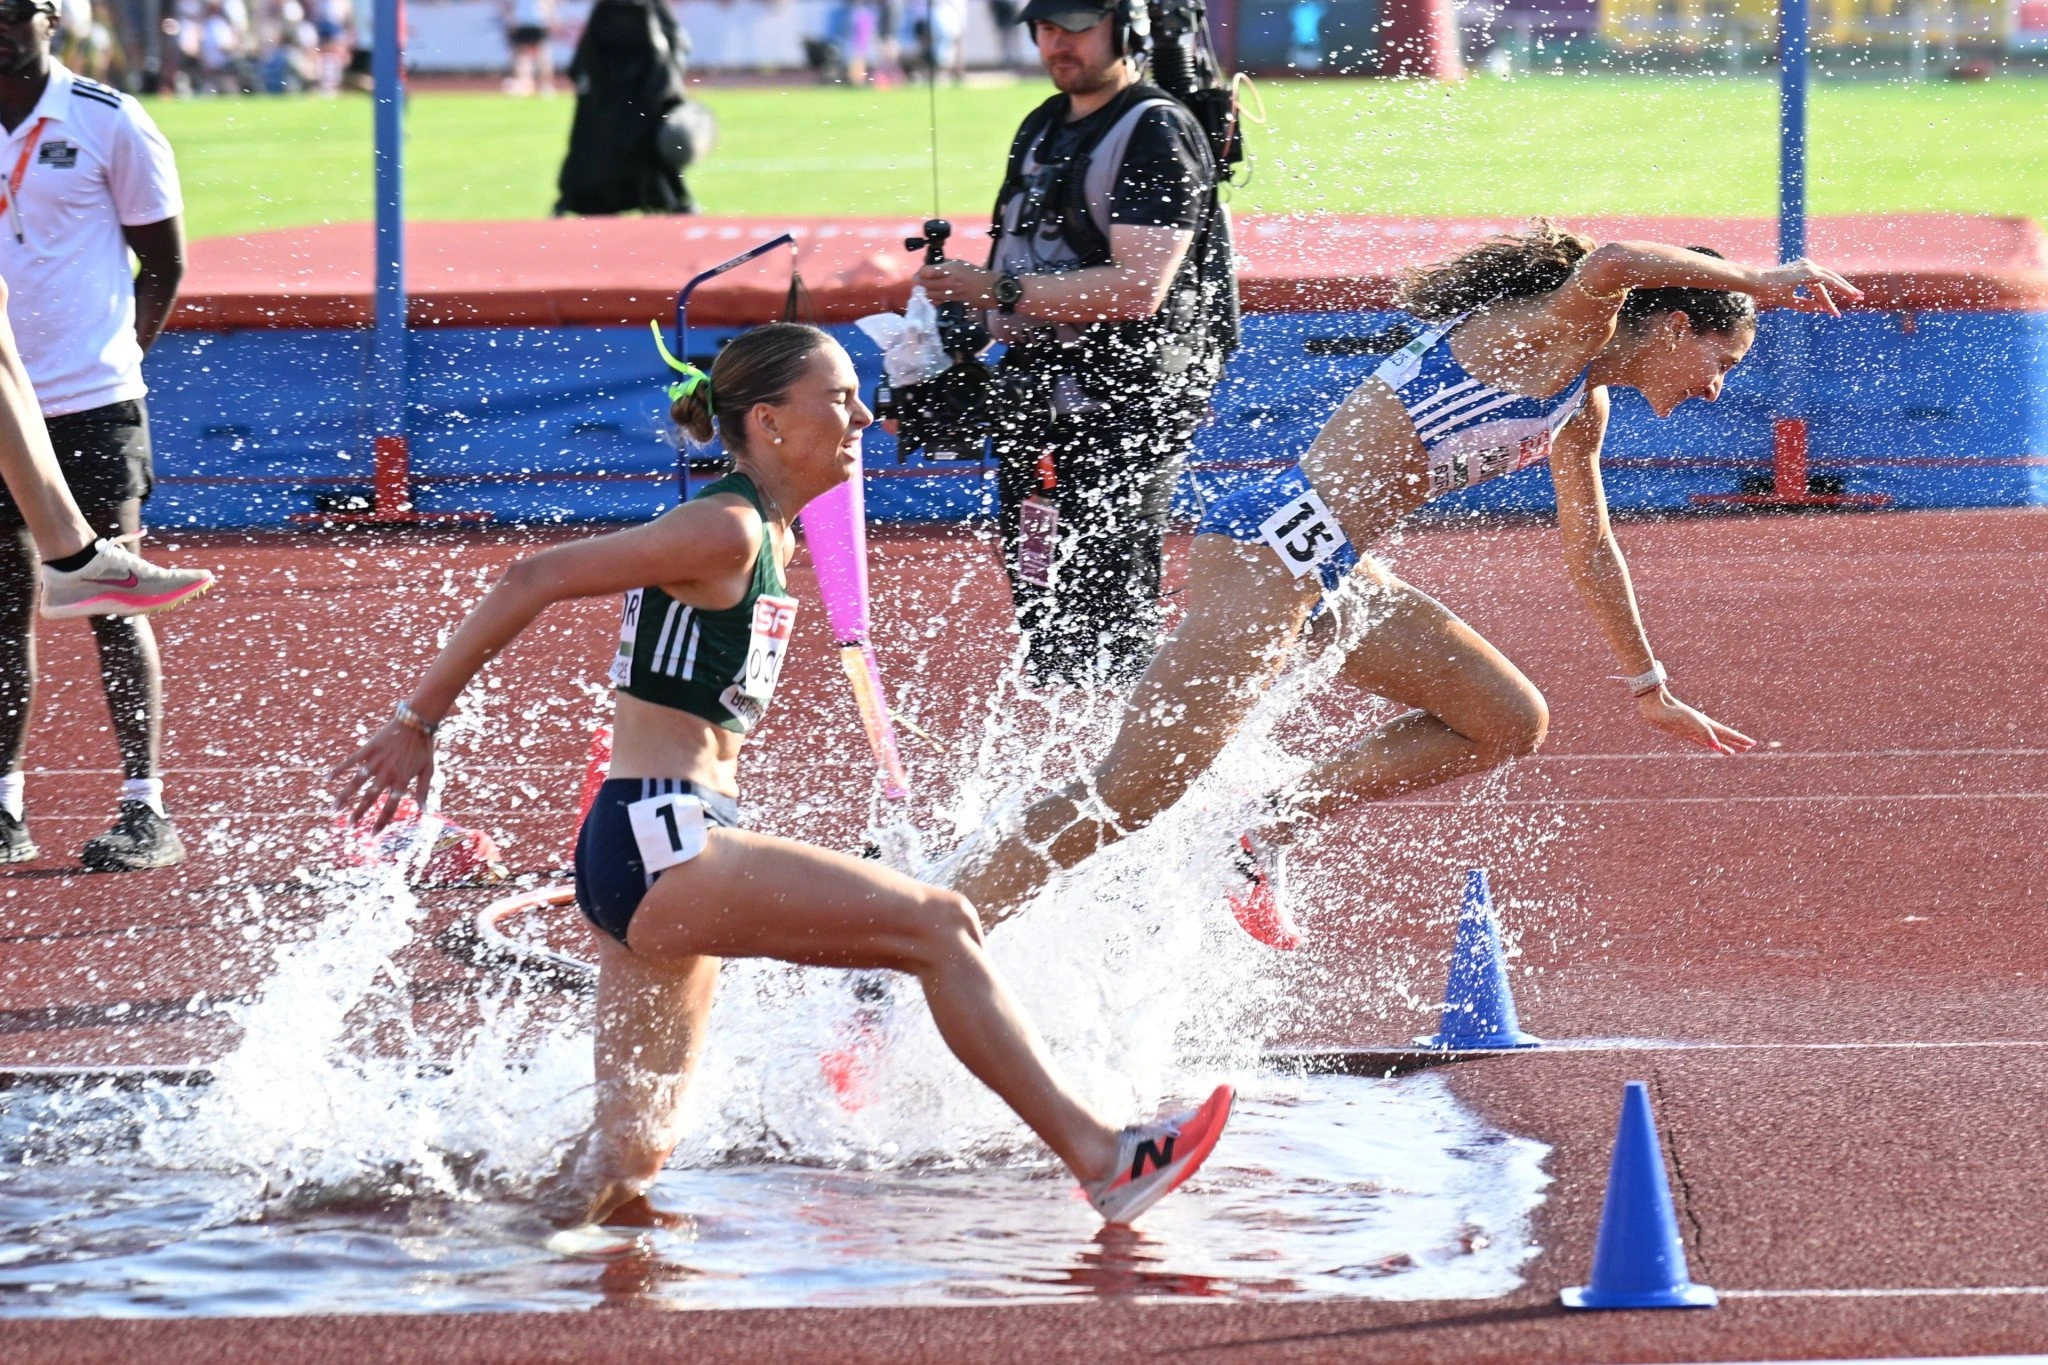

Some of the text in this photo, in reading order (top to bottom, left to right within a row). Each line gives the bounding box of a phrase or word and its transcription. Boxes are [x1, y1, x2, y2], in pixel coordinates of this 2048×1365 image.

[1274, 501, 1334, 562] 15
[655, 803, 684, 852] 1
[1130, 1135, 1176, 1180] N
